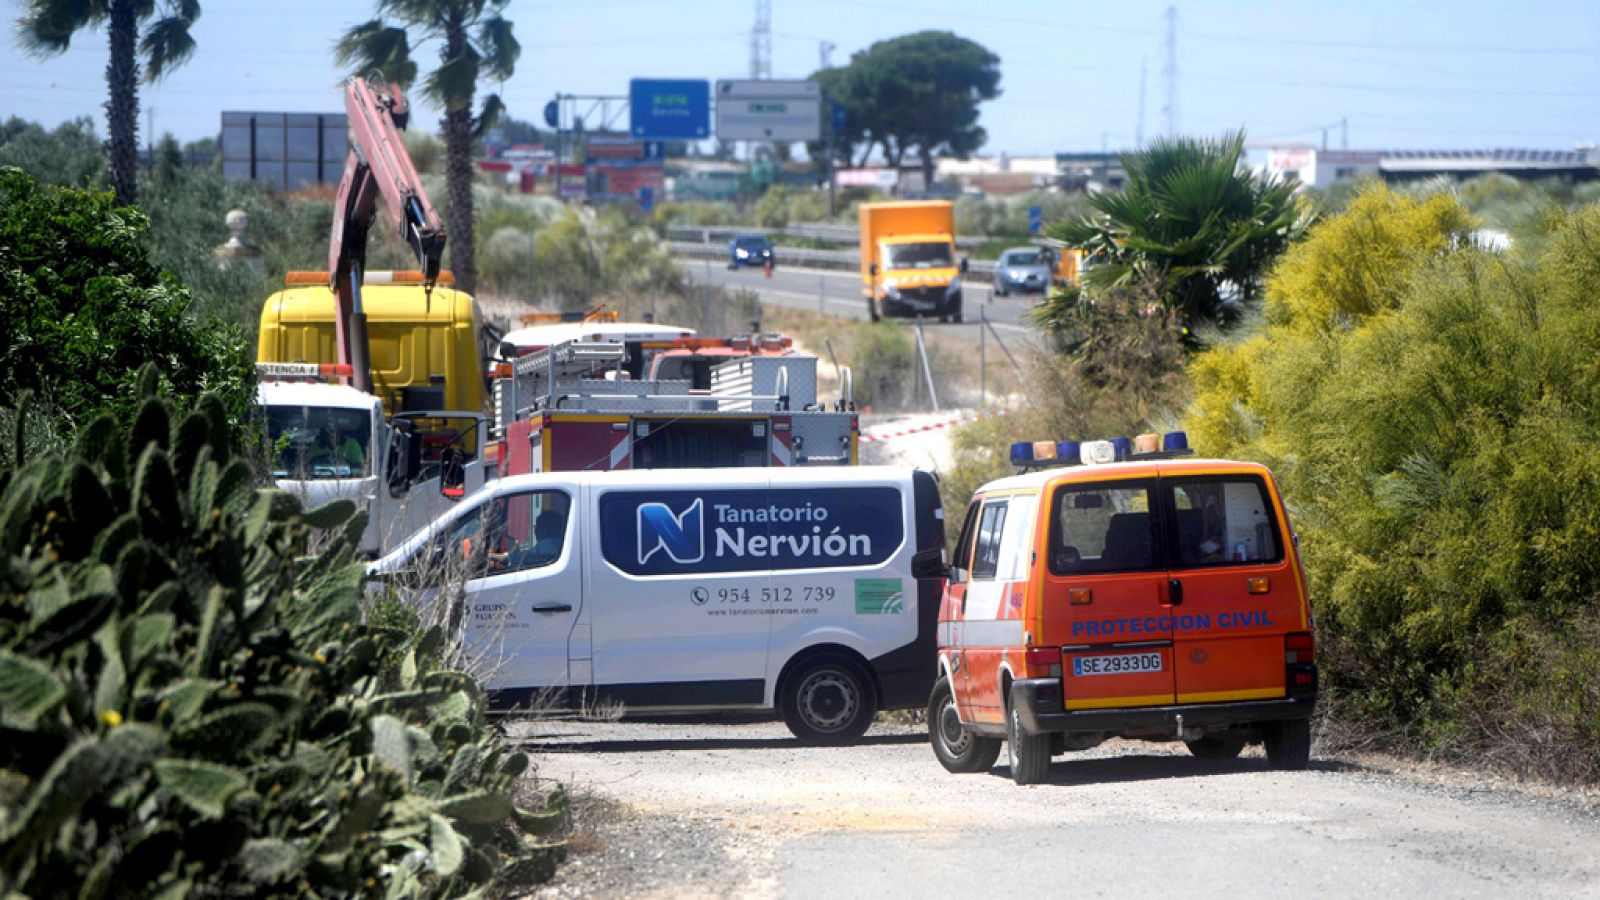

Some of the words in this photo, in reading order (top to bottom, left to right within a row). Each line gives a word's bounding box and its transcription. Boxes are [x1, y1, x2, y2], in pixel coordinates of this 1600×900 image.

[714, 502, 829, 524] Tanatorio
[714, 526, 872, 557] Nervión
[718, 587, 751, 602] 954
[761, 587, 793, 602] 512
[803, 586, 836, 601] 739
[1071, 613, 1210, 637] PROTECCION
[1217, 610, 1273, 628] CIVIL
